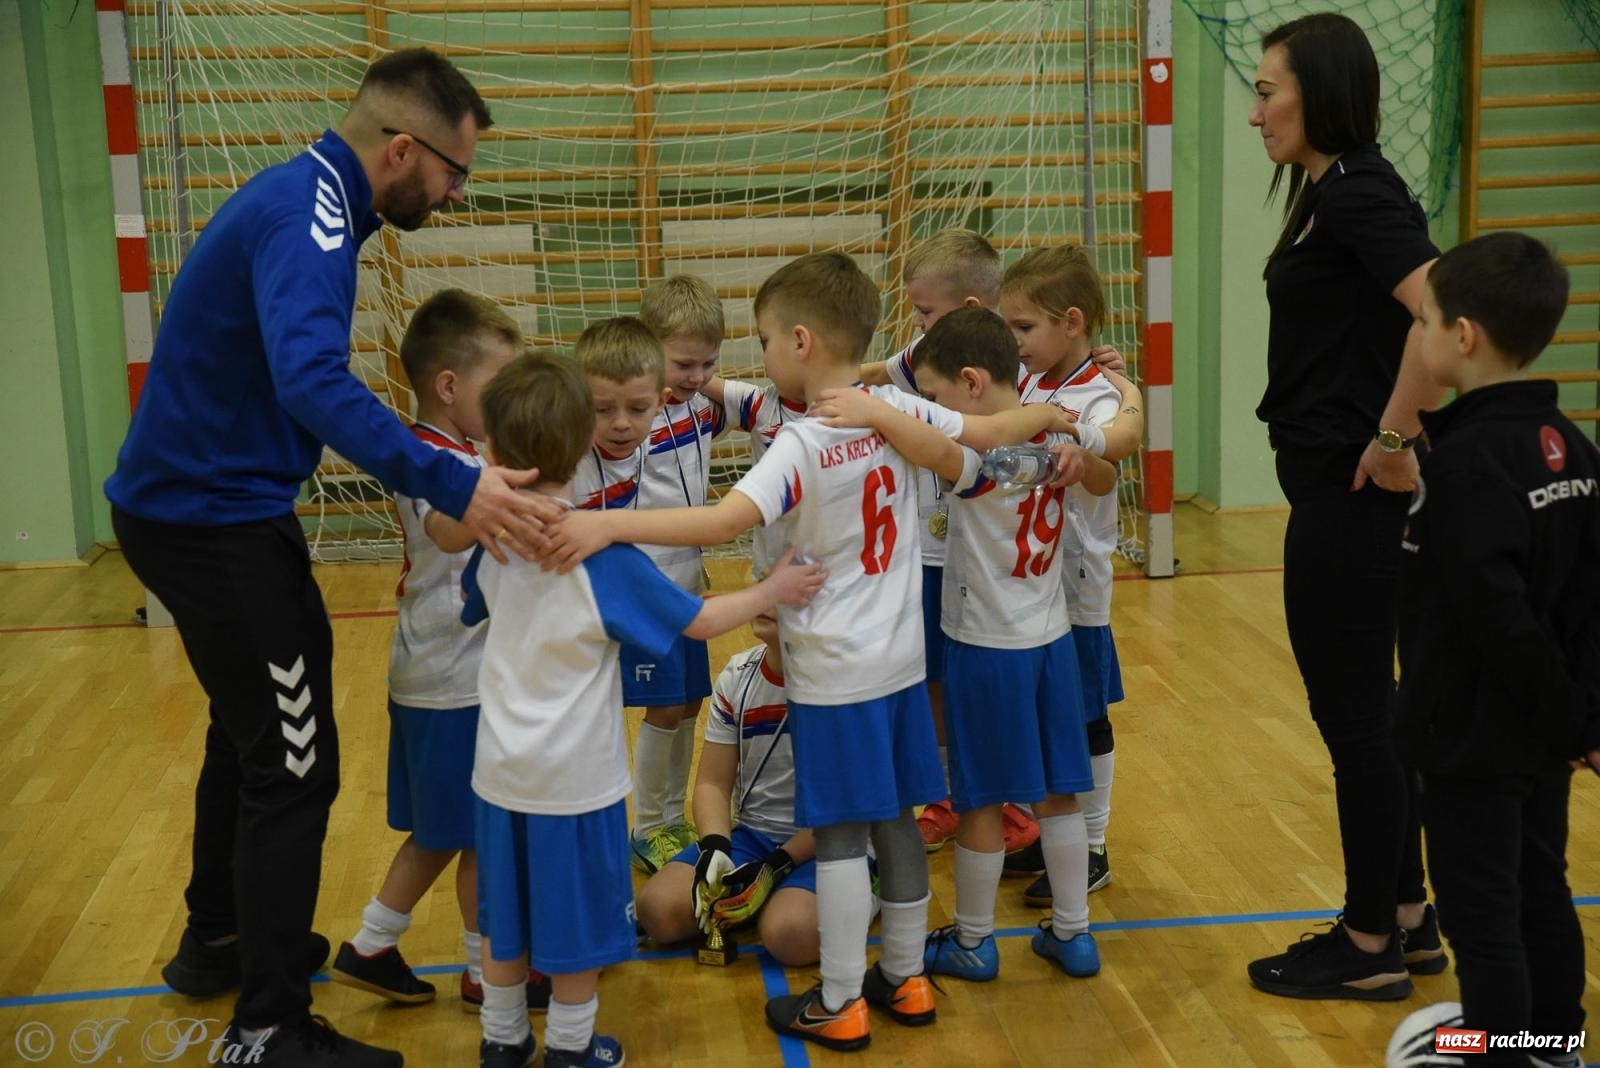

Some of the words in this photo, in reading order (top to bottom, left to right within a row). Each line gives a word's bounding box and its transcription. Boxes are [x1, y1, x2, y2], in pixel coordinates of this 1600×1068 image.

[820, 444, 844, 469] LKS
[860, 465, 898, 576] 6
[1011, 484, 1065, 579] 19
